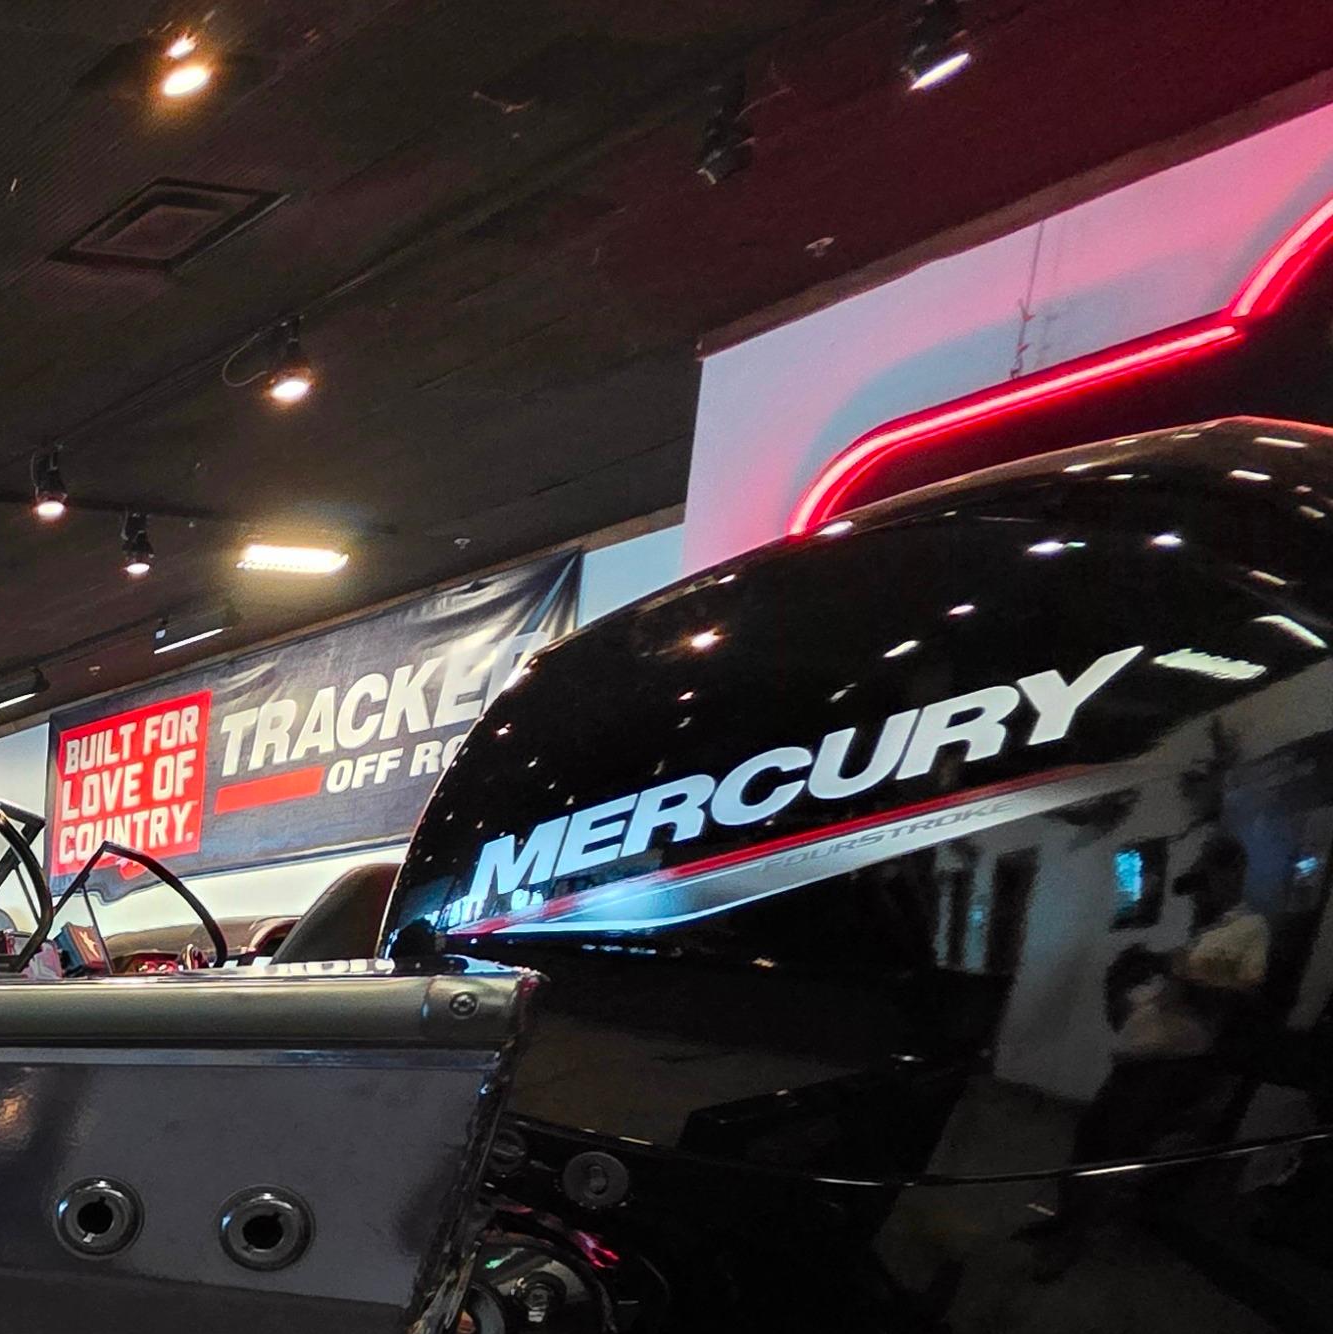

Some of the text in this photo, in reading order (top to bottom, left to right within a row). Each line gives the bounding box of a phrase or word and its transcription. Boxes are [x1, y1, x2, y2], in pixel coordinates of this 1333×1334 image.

[64, 705, 199, 775] BUILT FOR
[326, 748, 403, 793] OFF
[468, 646, 1144, 900] MERCURY
[61, 749, 197, 821] LOVE OF
[59, 801, 198, 864] COUNTRY.
[758, 800, 1015, 872] FOURSTROKE
